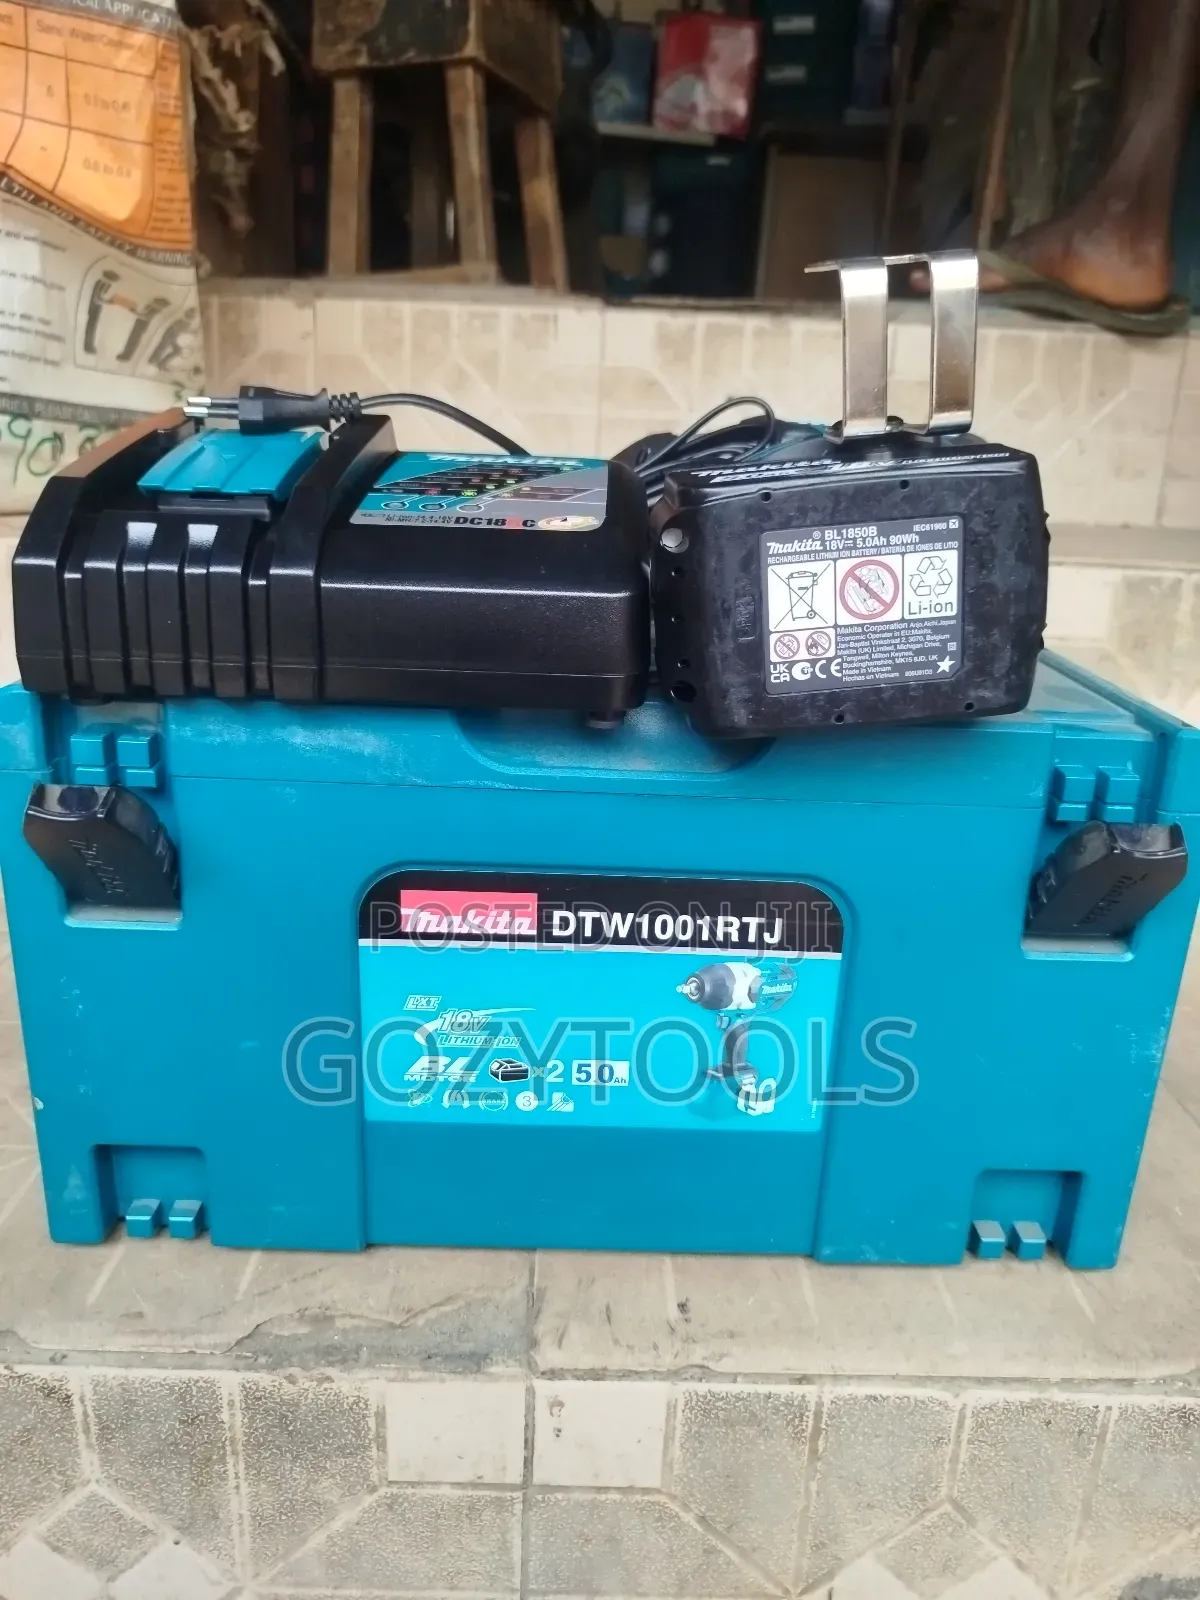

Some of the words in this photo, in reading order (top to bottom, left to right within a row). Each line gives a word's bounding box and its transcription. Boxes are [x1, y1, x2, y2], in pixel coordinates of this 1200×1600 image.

[824, 526, 877, 541] BL1850B
[856, 536, 887, 548] 5.0Ah
[889, 532, 919, 545] 90Wh
[767, 553, 815, 565] RECHARGEABLE
[815, 549, 839, 560] LITHIUM
[840, 548, 851, 558] ION
[906, 544, 914, 552] DE
[915, 542, 934, 552] IONES
[934, 541, 943, 550] DE
[943, 540, 959, 549] LITIO
[908, 599, 954, 616] Li-ion
[836, 626, 862, 635] Makita
[863, 621, 908, 632] Corporation
[836, 634, 866, 642] Economic
[925, 633, 950, 641] Belgium
[857, 646, 872, 655] (UK)
[896, 642, 923, 650] Michigan
[770, 663, 790, 674] UK
[842, 668, 860, 676] Made
[867, 665, 892, 673] Vietnam
[874, 671, 899, 679] Vietnam
[770, 673, 791, 683] CA
[552, 910, 784, 945] DTW1001RTJ
[406, 995, 441, 1010] LXT
[407, 1055, 480, 1075] BL
[403, 1074, 477, 1083] MOTOR
[521, 1095, 533, 1108] 3
